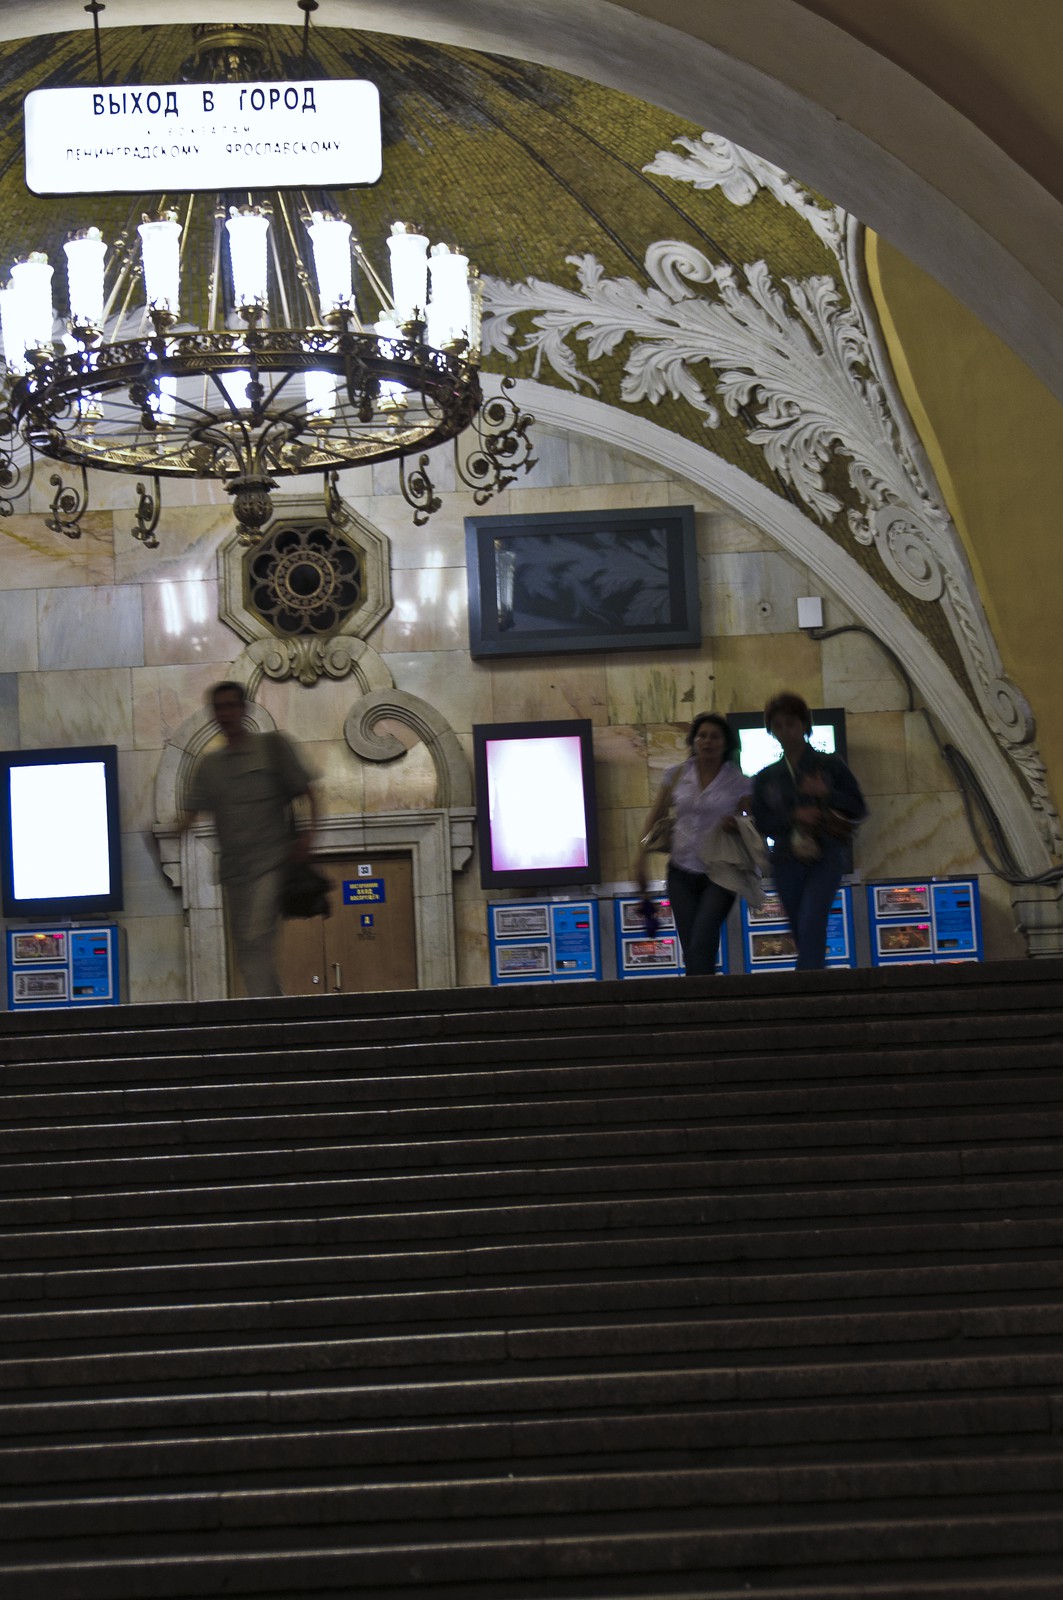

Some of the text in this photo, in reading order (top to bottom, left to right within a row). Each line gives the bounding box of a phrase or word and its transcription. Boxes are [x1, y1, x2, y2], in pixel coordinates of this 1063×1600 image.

[92, 87, 317, 119] ВЫХОД В ГОРОД
[167, 126, 250, 137] ВОЗАЛАМ
[225, 140, 341, 156] ЯРОСЛАВСКОМУ
